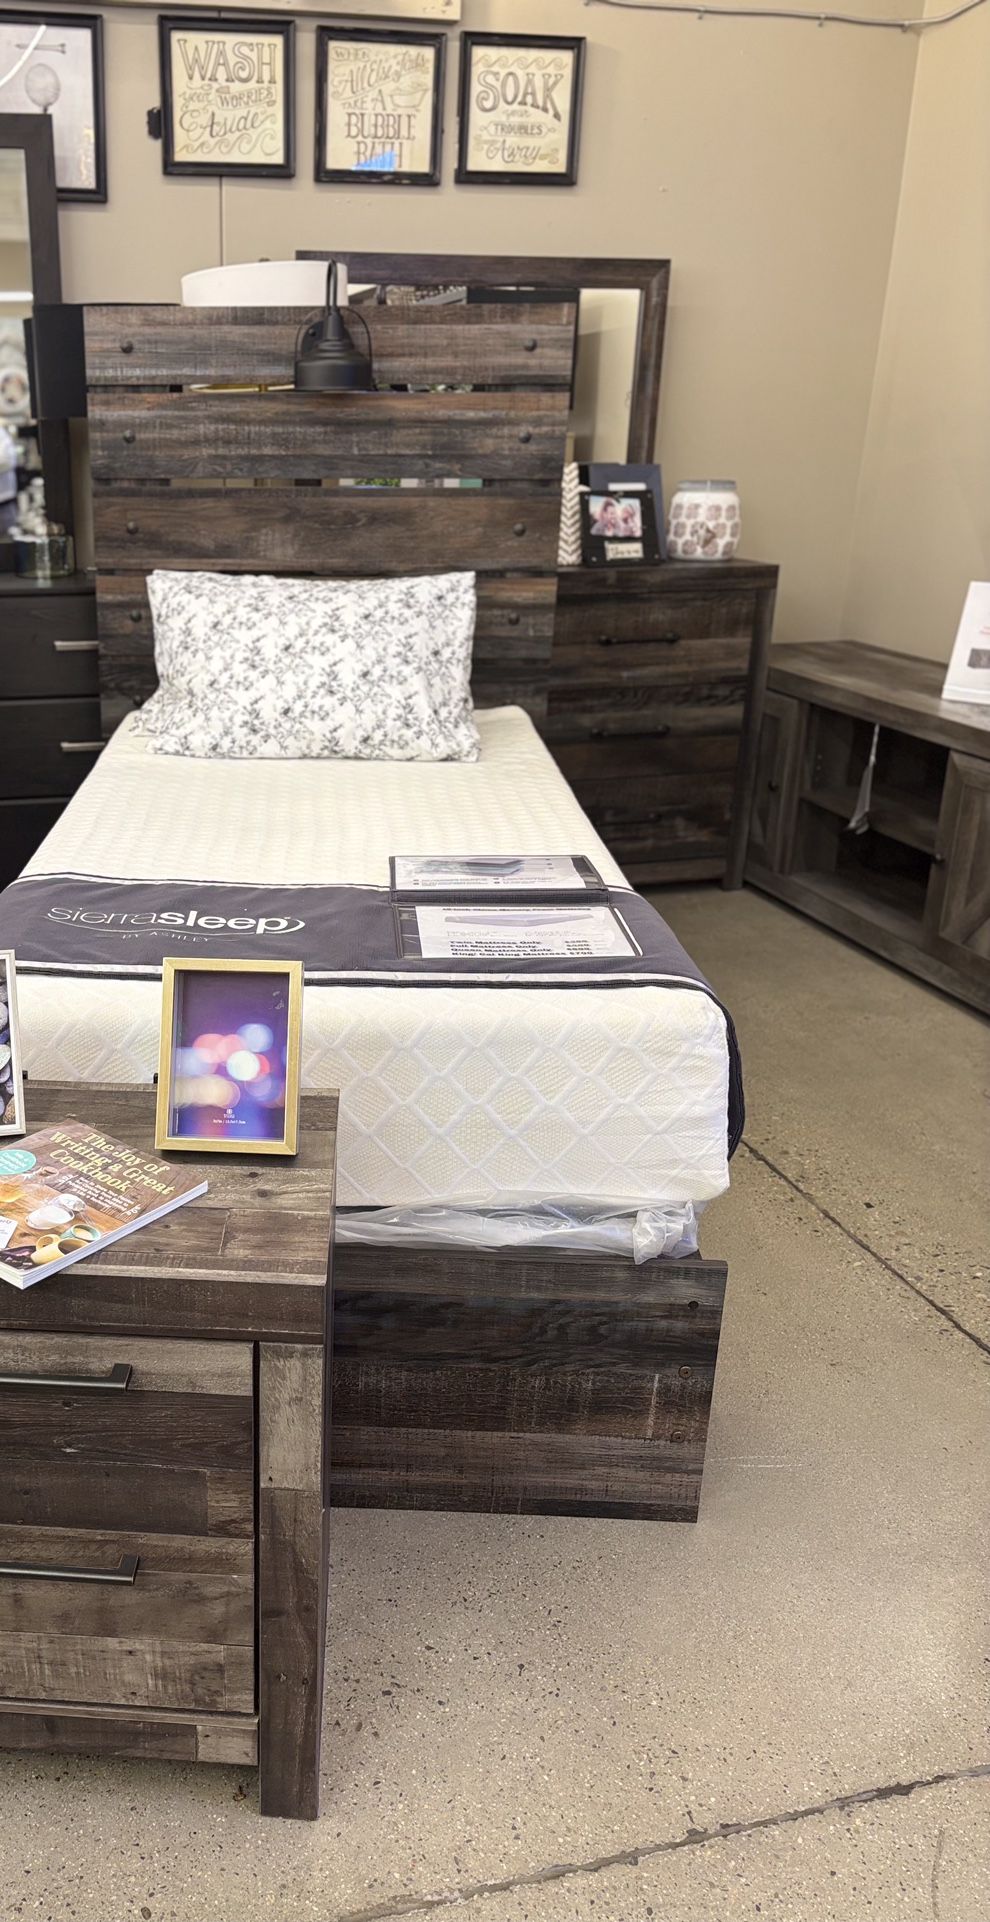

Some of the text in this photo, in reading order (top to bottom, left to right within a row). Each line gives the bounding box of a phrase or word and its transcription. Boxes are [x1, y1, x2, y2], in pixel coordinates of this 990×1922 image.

[177, 39, 277, 84] WASH
[217, 86, 273, 108] WORRIES
[341, 89, 386, 111] TAKE A
[476, 70, 564, 122] SOAK
[180, 111, 270, 140] Aside
[345, 112, 416, 141] BUBBLE
[494, 123, 543, 136] TROUBLES
[354, 141, 403, 169] BATH
[485, 139, 542, 166] Away
[50, 1132, 112, 1167] Writing
[108, 1163, 123, 1172] a
[123, 1168, 175, 1195] Great
[82, 1133, 170, 1175] The Joy of
[50, 1149, 133, 1192] Cookbook
